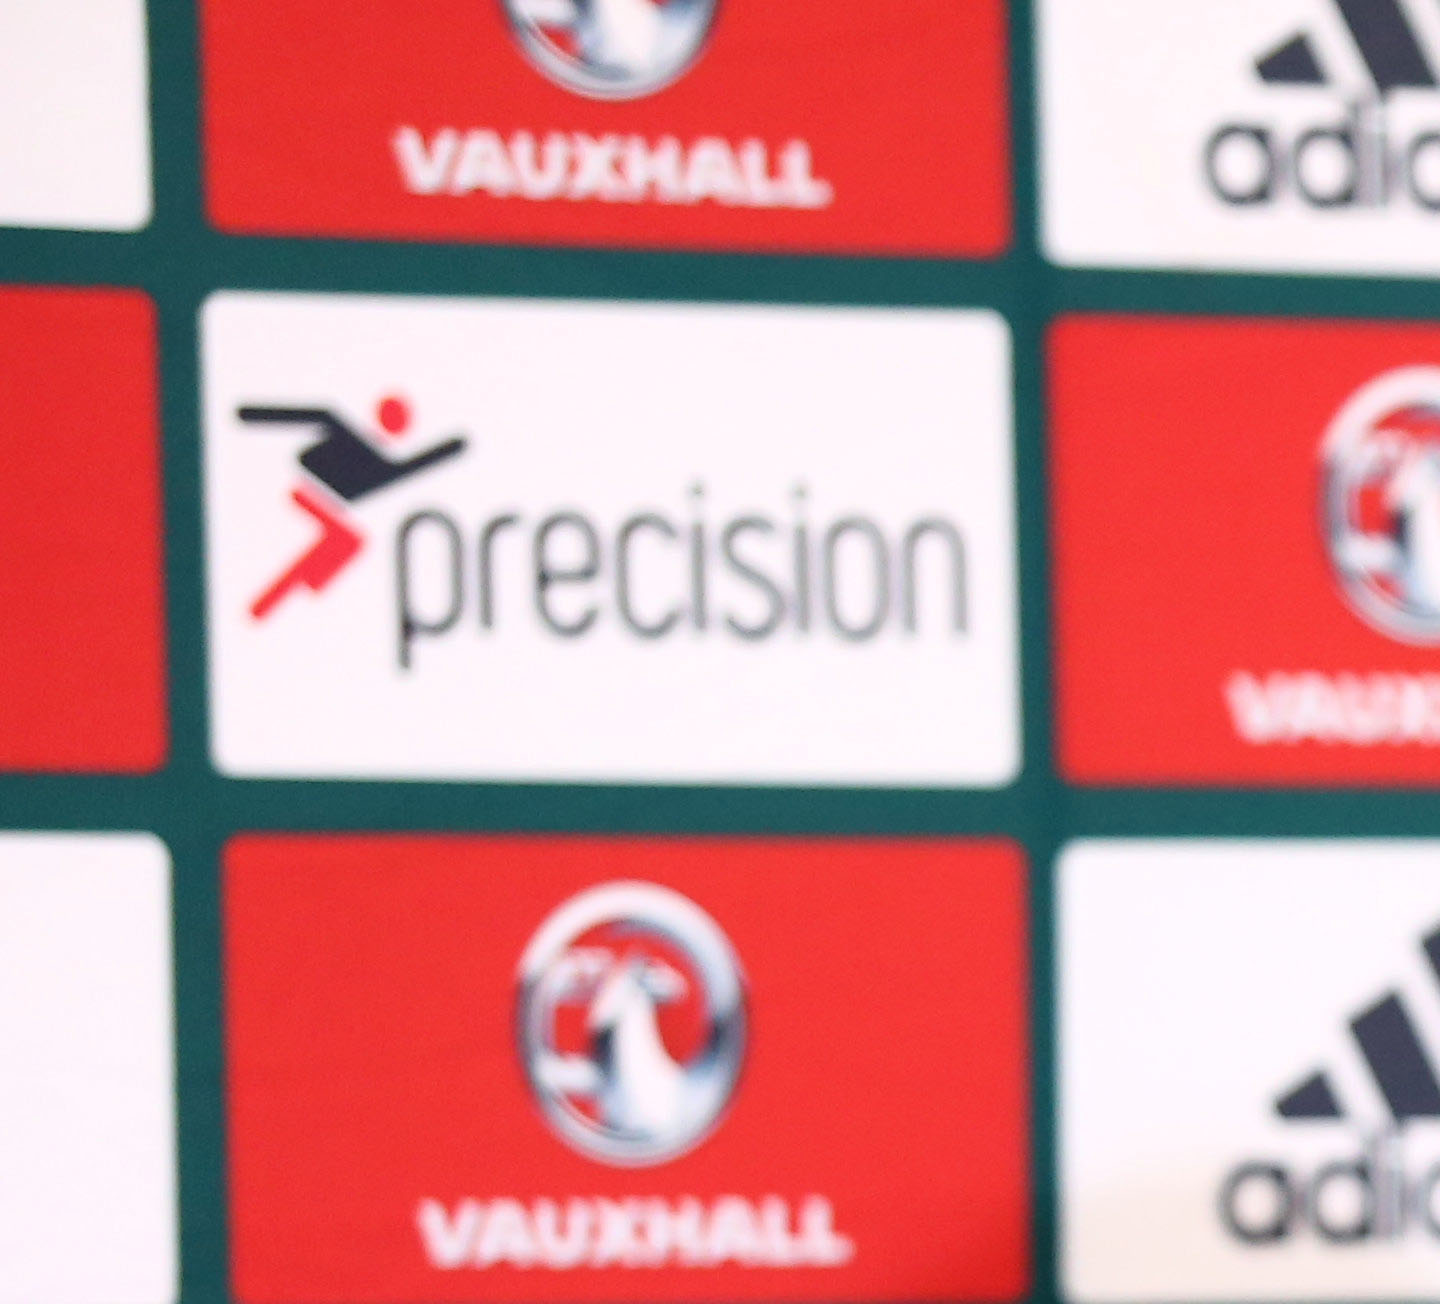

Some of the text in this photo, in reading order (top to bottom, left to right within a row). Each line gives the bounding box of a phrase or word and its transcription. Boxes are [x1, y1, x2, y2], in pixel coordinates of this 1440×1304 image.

[393, 126, 832, 209] VAUXHALL
[396, 482, 969, 676] precision
[414, 1196, 852, 1268] VAUXHALL
